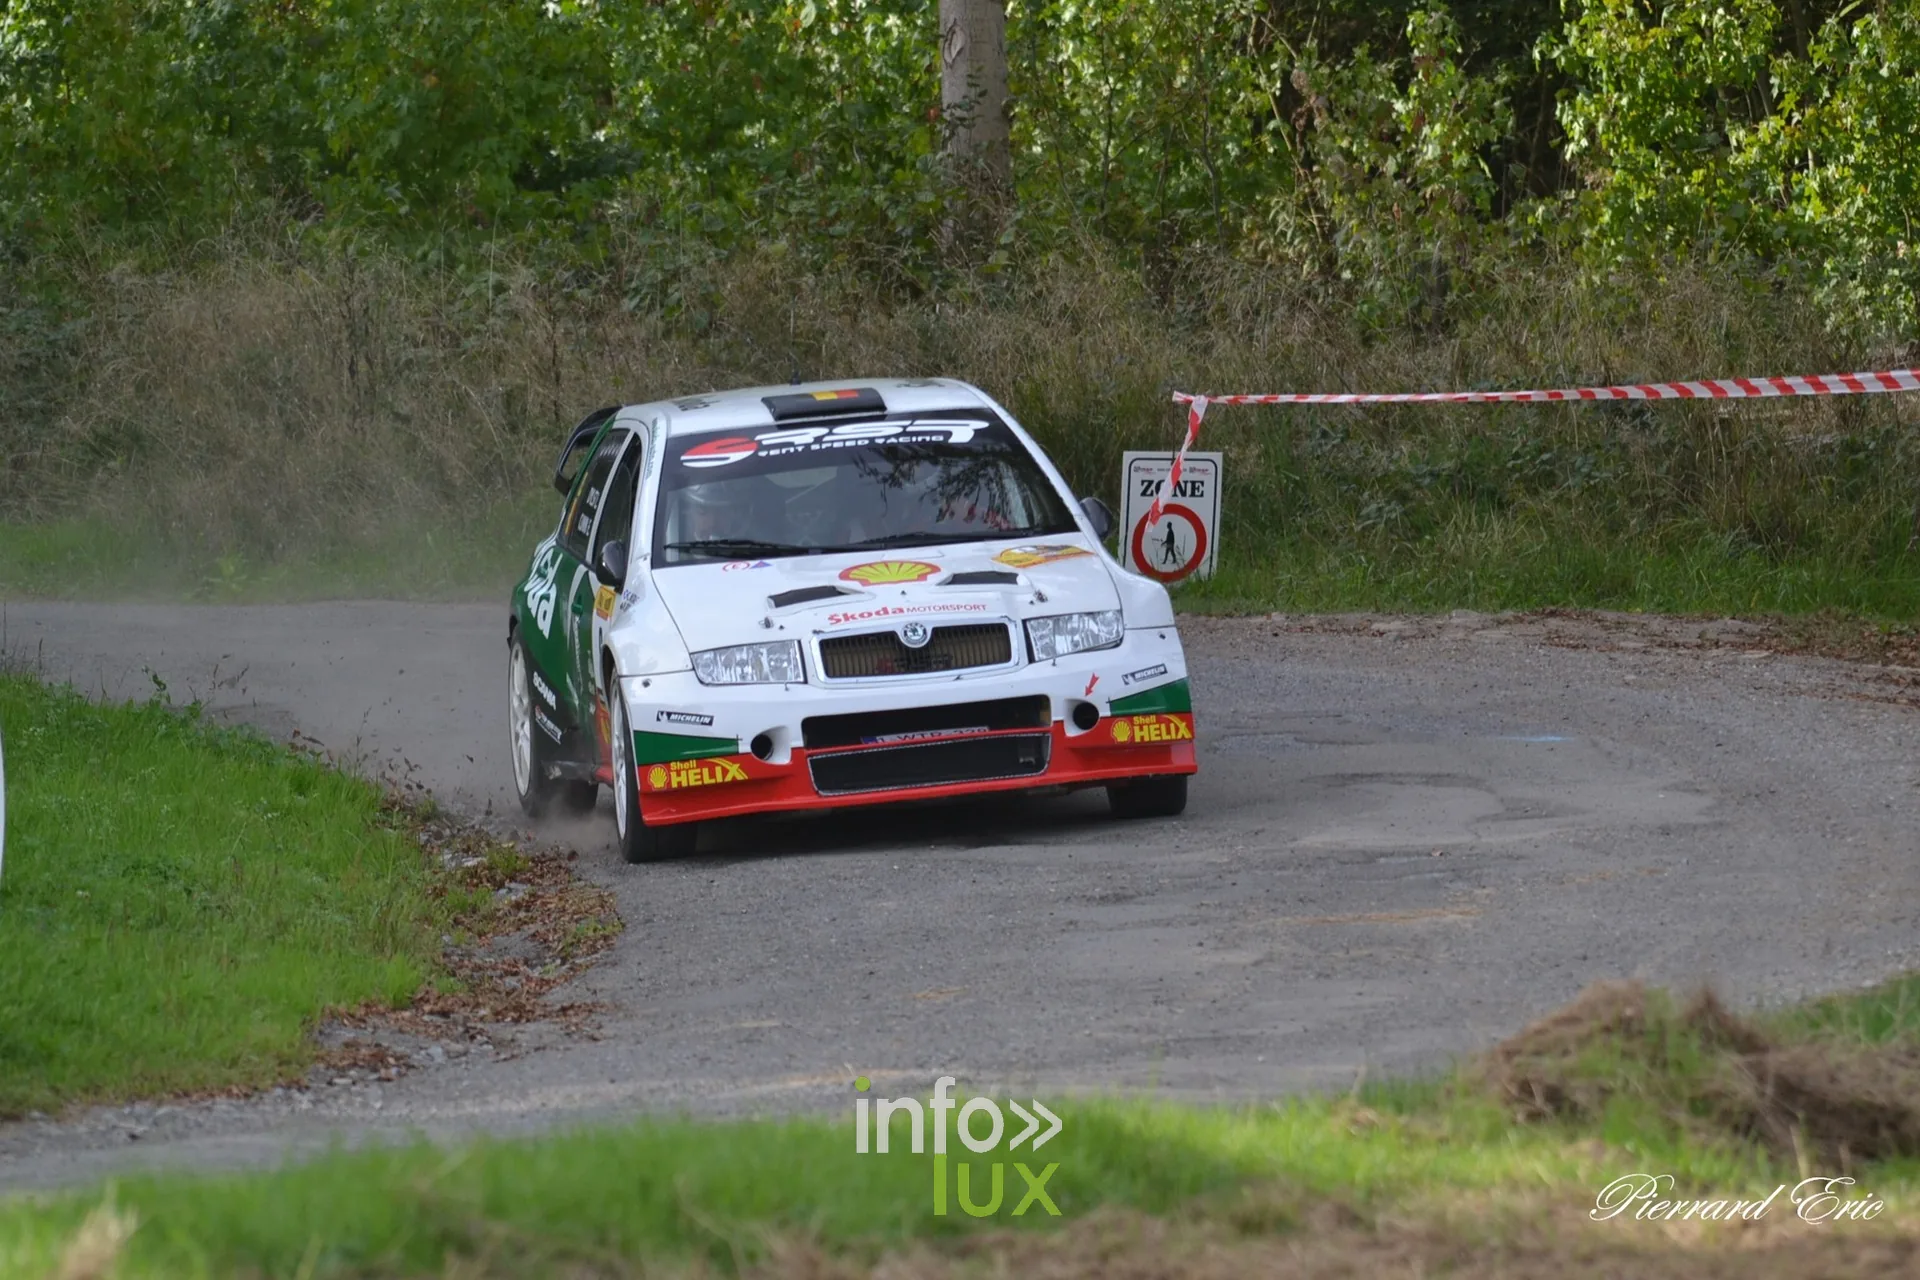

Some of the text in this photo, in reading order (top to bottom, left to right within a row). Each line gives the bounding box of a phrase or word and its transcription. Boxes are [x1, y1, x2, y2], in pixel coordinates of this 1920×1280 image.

[810, 439, 869, 451] SPEED
[906, 604, 987, 614] MOTORSPORT
[669, 713, 711, 725] MICHELIN
[1133, 715, 1157, 725] Shell
[1133, 720, 1192, 743] HELIX
[670, 759, 697, 771] Shell
[670, 762, 748, 789] HELIX
